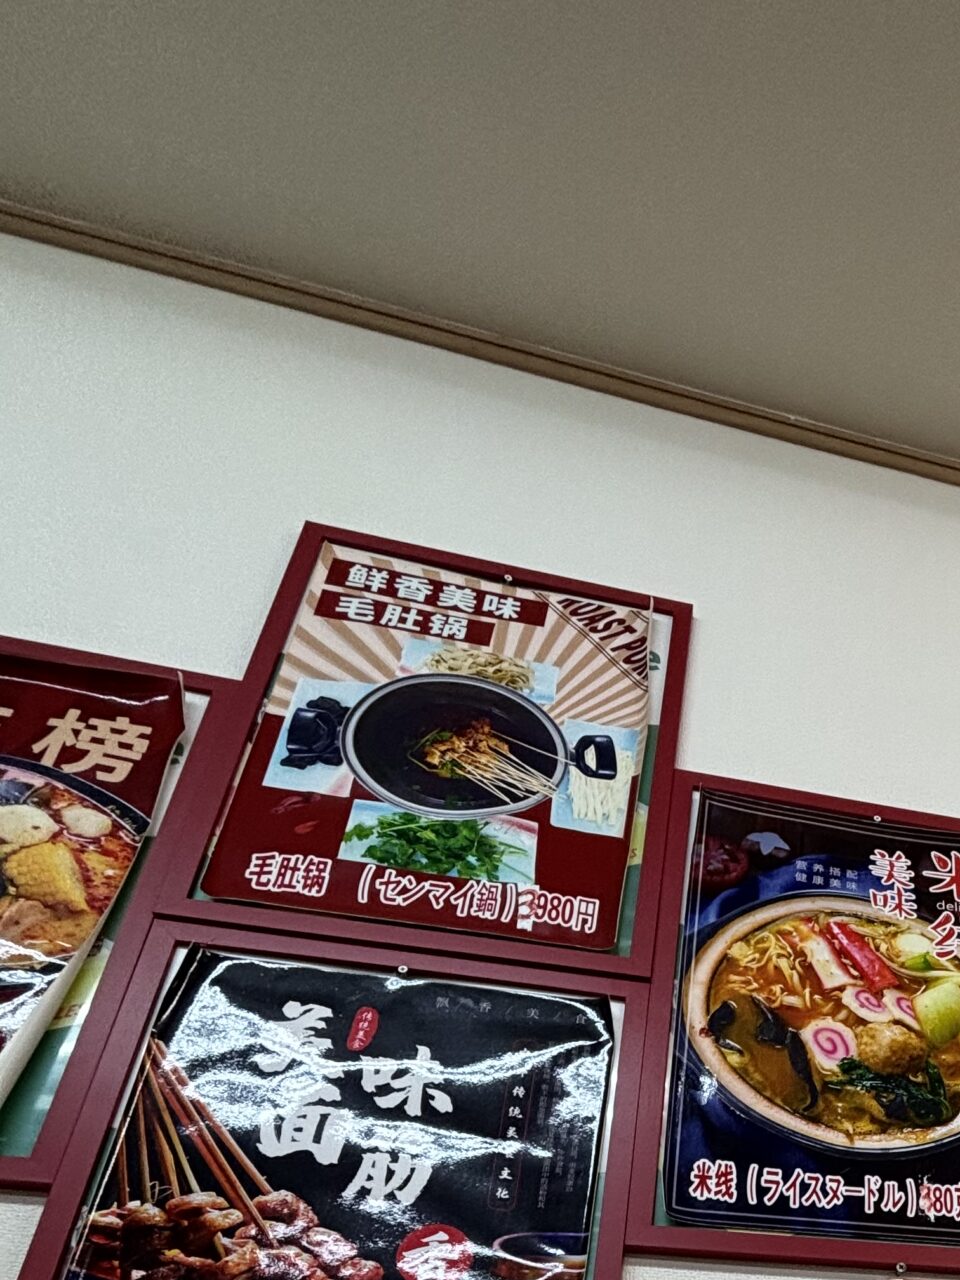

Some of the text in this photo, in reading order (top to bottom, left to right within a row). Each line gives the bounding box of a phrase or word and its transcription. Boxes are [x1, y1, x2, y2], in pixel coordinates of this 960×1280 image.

[335, 595, 469, 642] 毛肚锅
[345, 563, 521, 620] 鲜香美味
[0, 707, 152, 783] 榜
[244, 852, 332, 897] 毛肚锅
[868, 848, 918, 920] 美味
